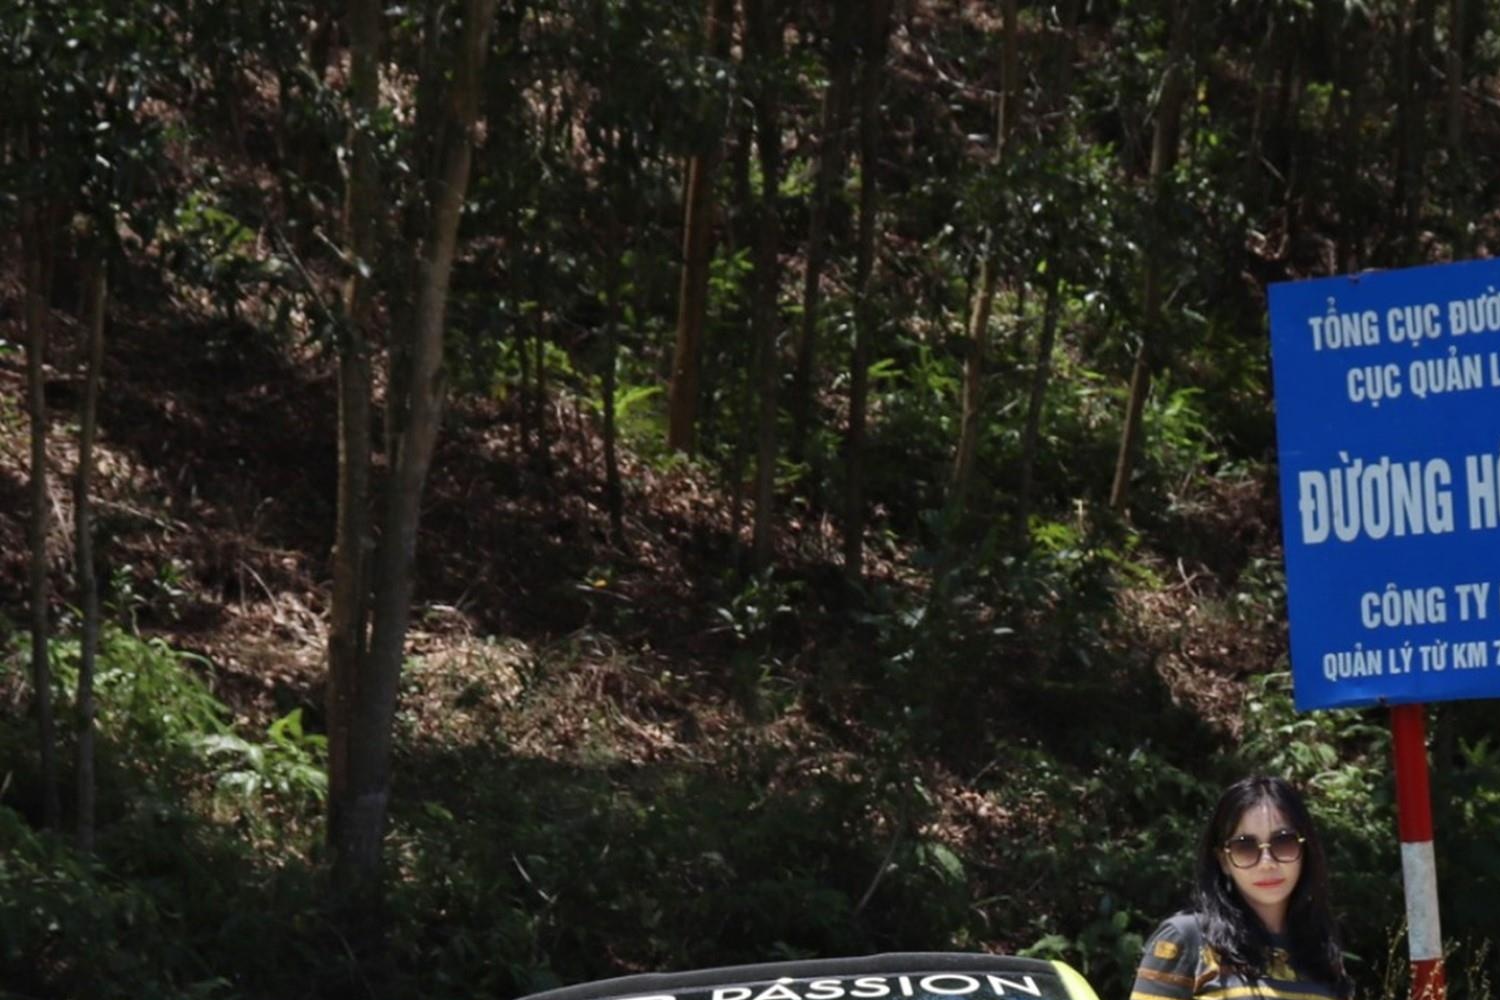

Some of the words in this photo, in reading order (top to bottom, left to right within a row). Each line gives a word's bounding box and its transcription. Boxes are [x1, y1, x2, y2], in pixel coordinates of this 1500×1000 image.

[1309, 297, 1380, 350] TỔNG
[1387, 303, 1441, 347] CỤC
[1347, 363, 1402, 407] CỤC
[1409, 345, 1483, 399] QUẢN
[1361, 583, 1447, 629] CÔNG
[1455, 582, 1490, 621] TY
[1323, 642, 1383, 682] QUẢN
[1389, 641, 1413, 674] LÝ
[1419, 639, 1448, 672] TỪ
[1453, 641, 1488, 669] KM
